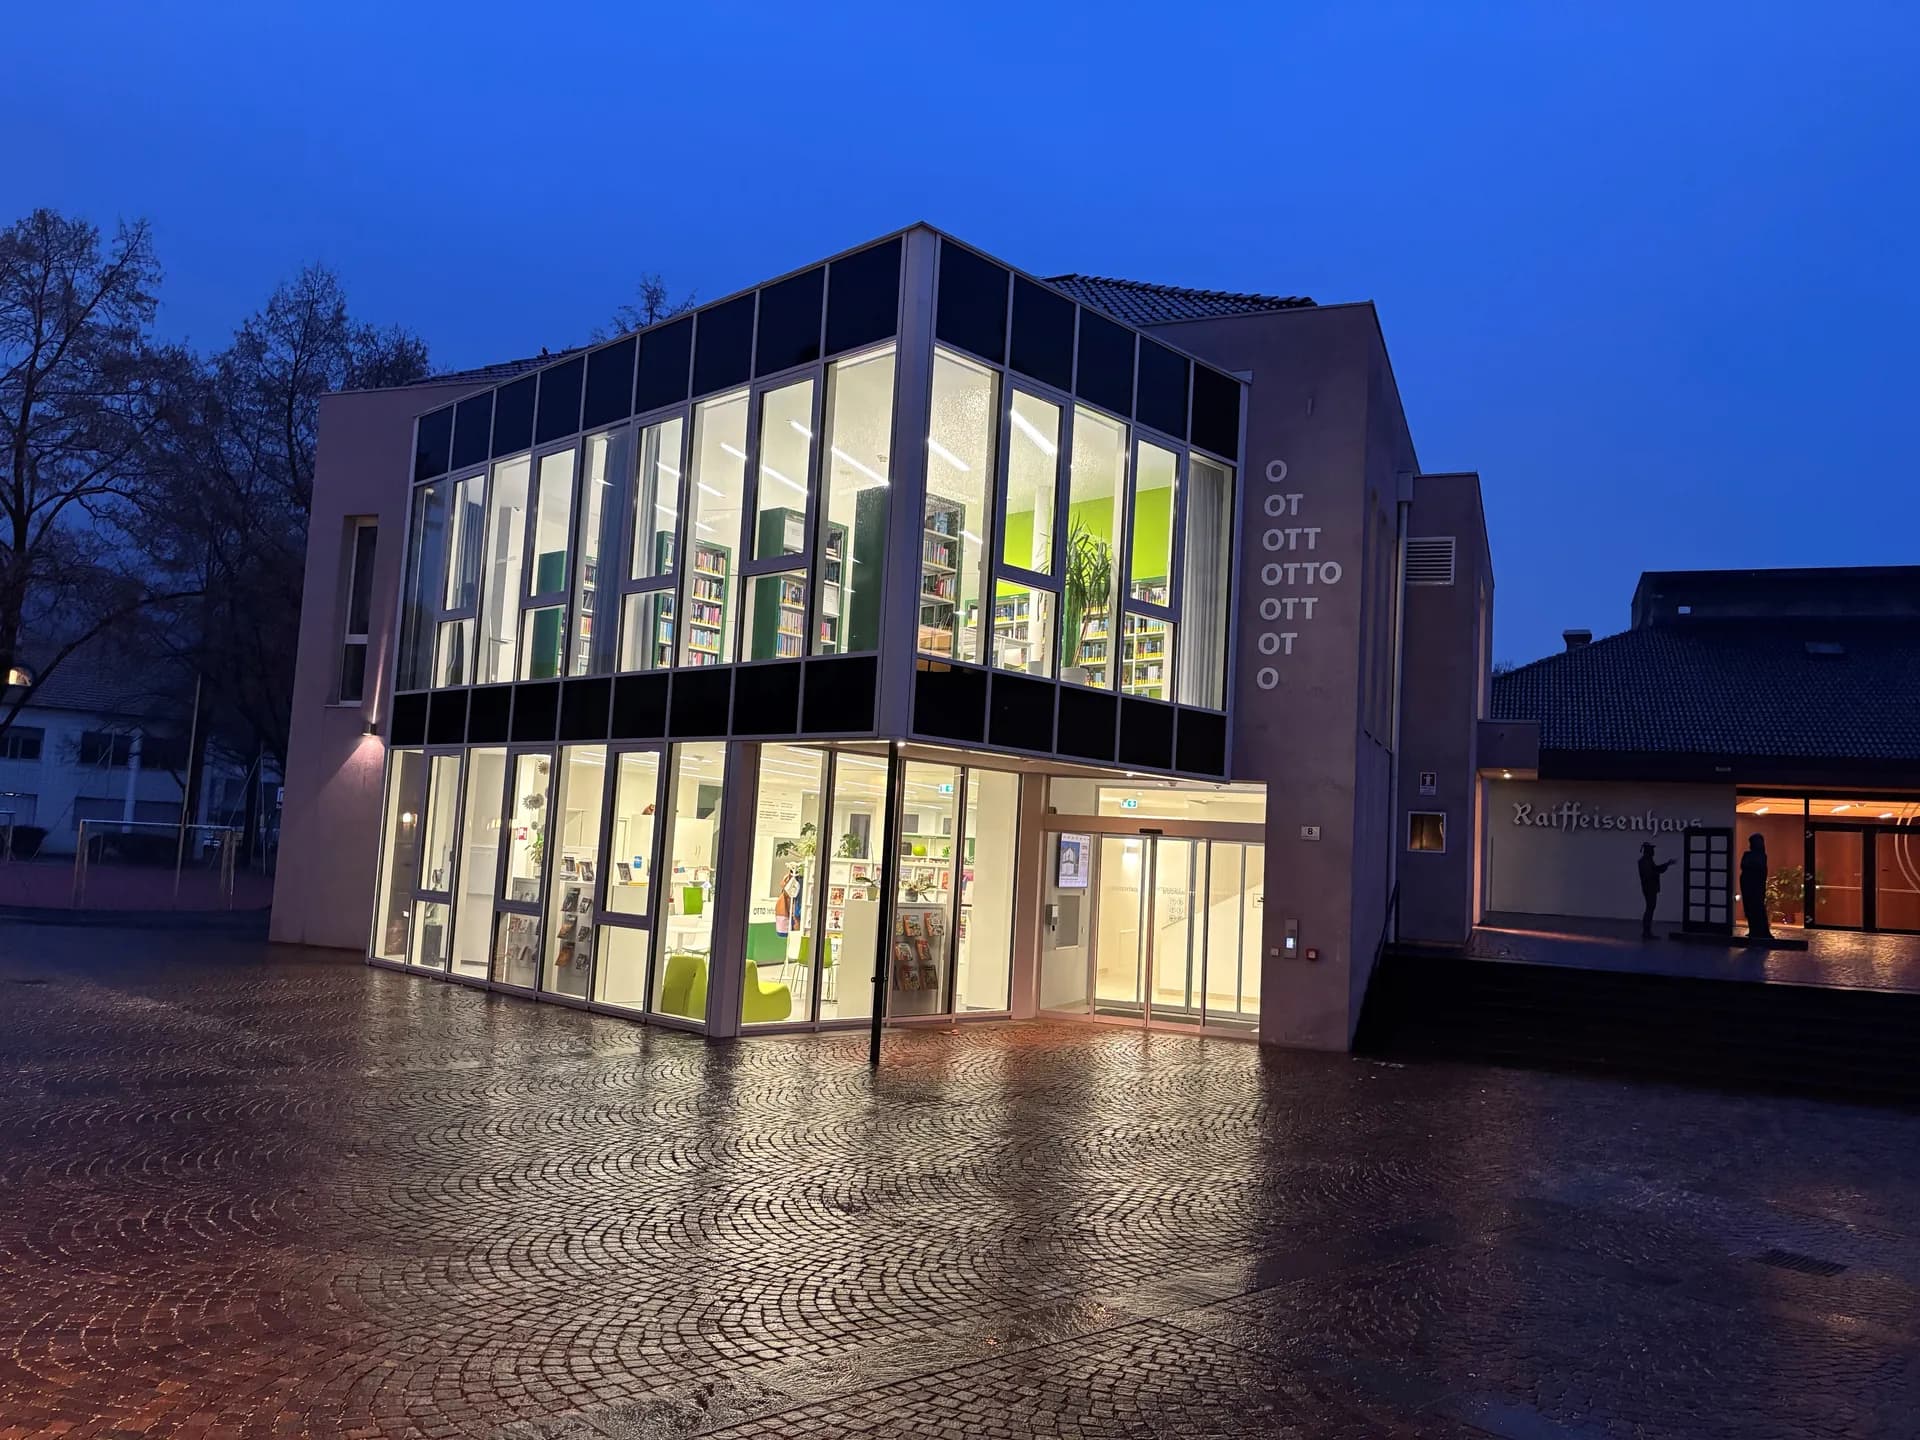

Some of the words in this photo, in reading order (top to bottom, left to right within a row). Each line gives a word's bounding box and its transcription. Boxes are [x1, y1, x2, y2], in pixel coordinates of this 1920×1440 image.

[1265, 459, 1288, 482] O
[1264, 494, 1304, 517] OT
[1262, 528, 1321, 551] OTT
[1261, 562, 1343, 586] OTTO
[1260, 598, 1319, 621] OTT
[1258, 632, 1298, 655] OT
[1257, 667, 1279, 690] O
[1307, 827, 1314, 836] 8
